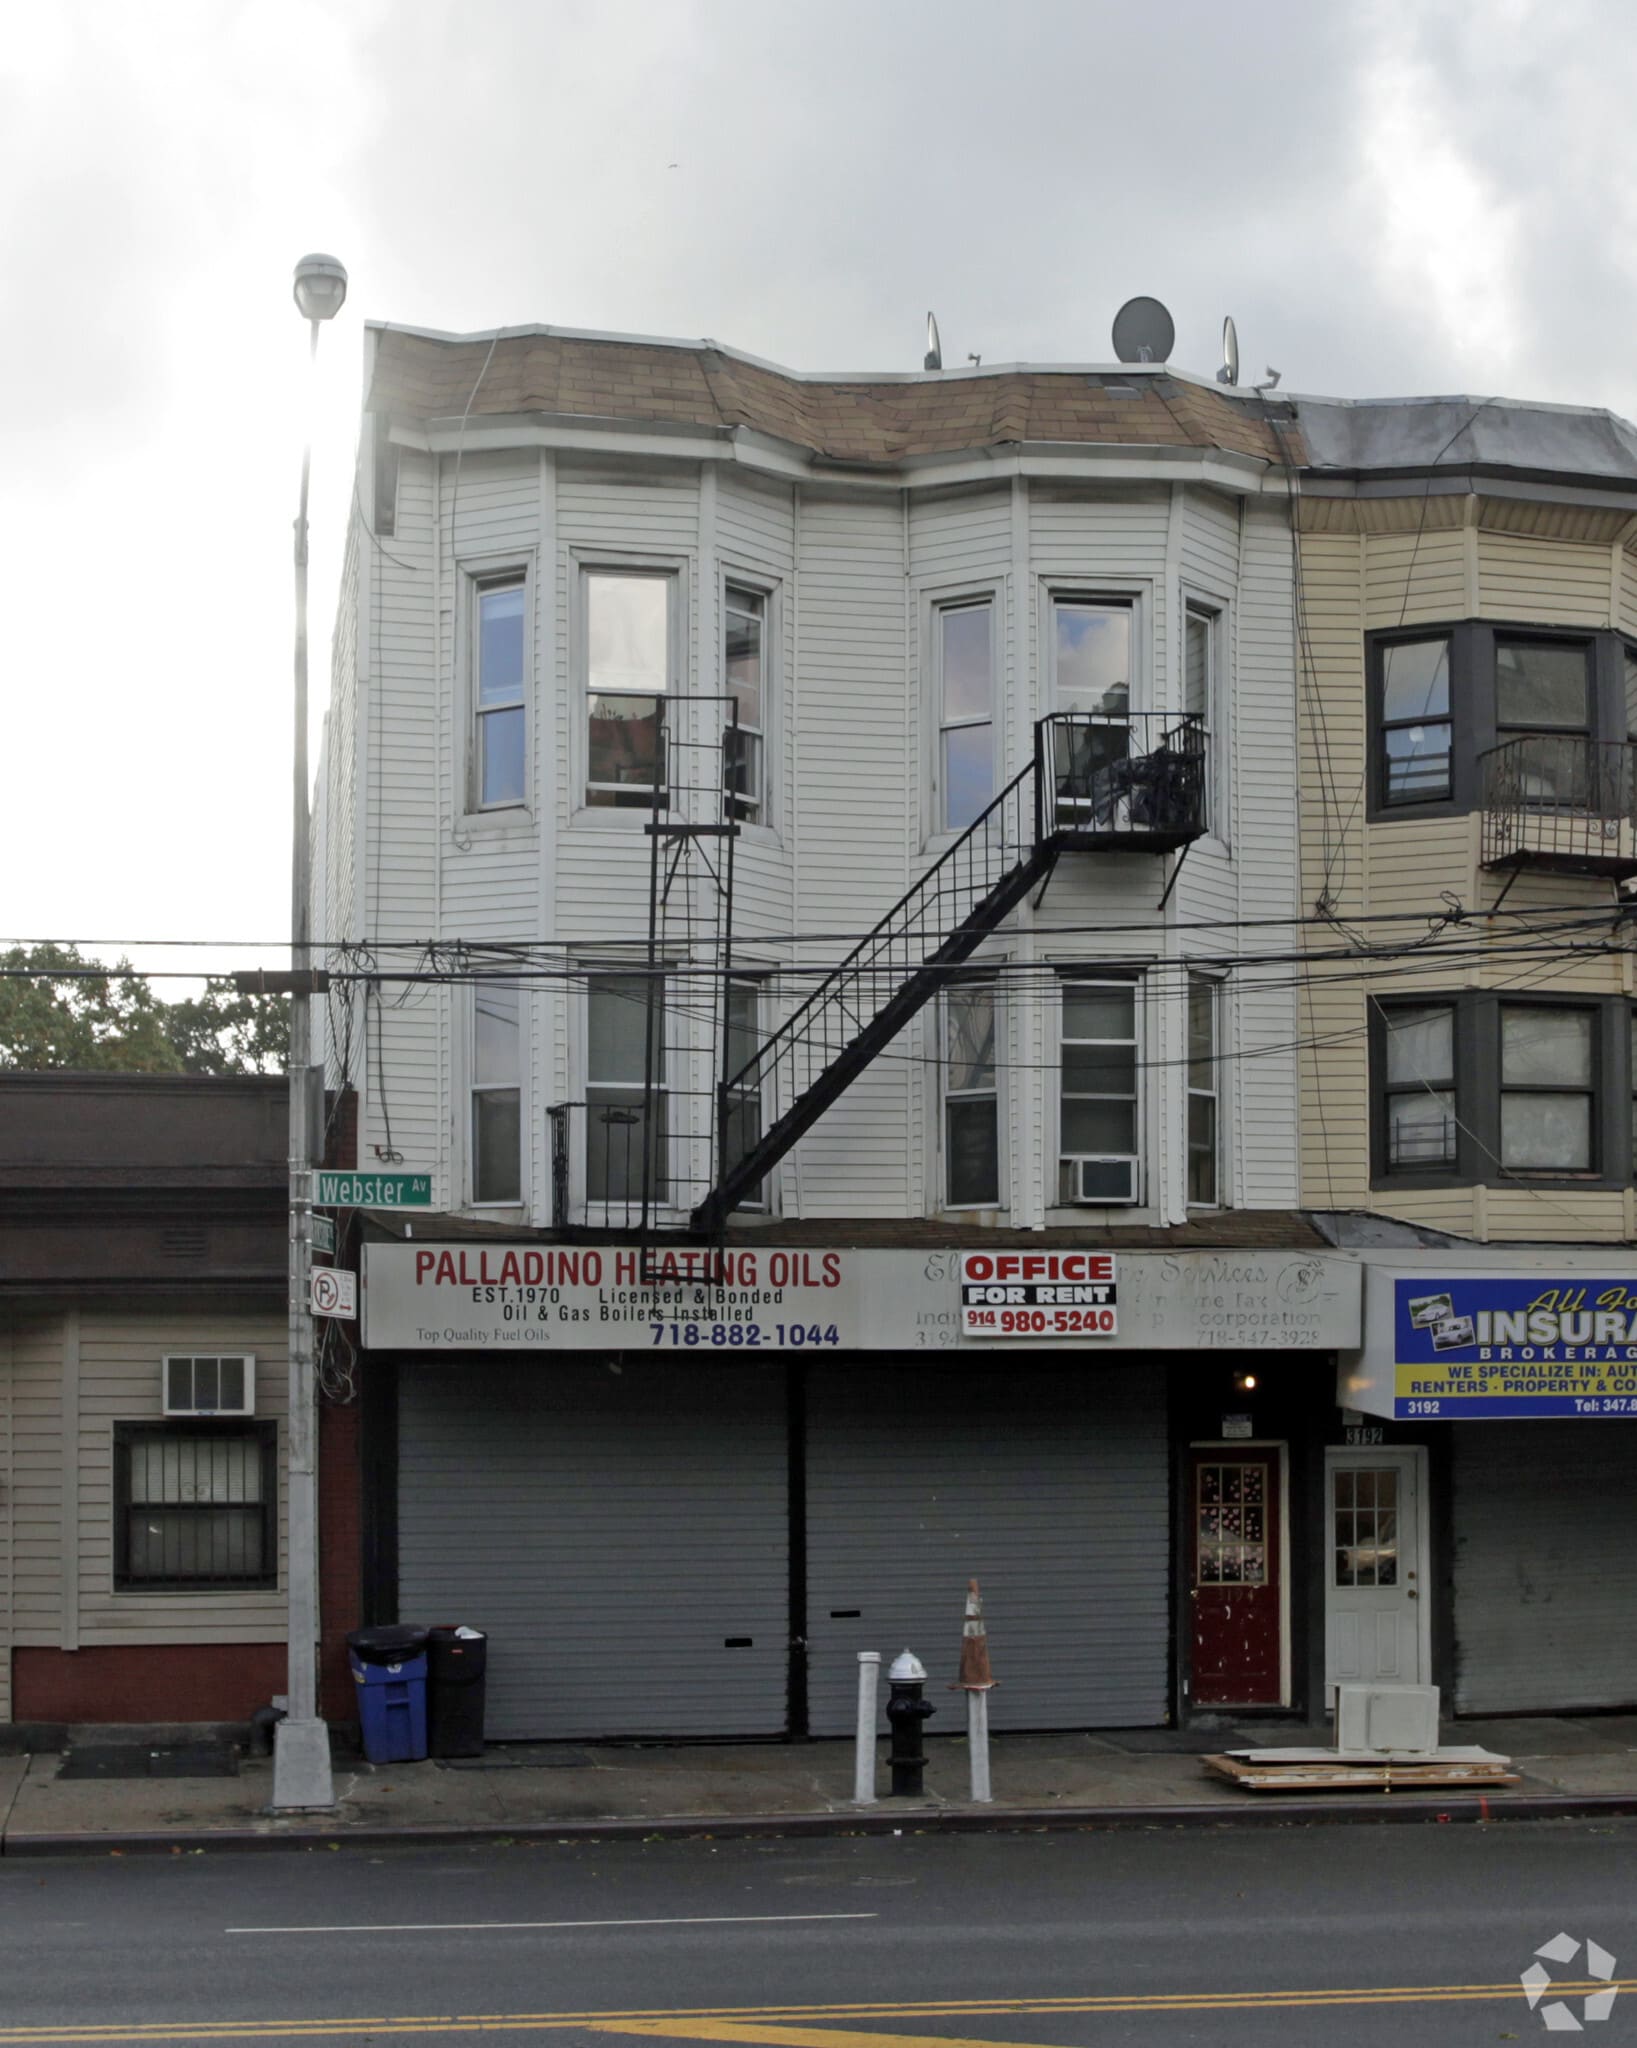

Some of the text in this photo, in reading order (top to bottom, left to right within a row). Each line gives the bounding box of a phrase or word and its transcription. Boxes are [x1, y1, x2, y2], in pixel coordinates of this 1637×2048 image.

[322, 1176, 426, 1203] Webster Av
[415, 1250, 841, 1288] PALLADINO HEATING OILS
[965, 1255, 1113, 1281] OFFICE
[473, 1287, 783, 1304] EST.1970 Licensed & Bonded
[968, 1286, 1110, 1304] FOR RENT
[1527, 1288, 1587, 1313] All
[503, 1304, 753, 1321] Oil & Gas Boilers Installed
[968, 1310, 996, 1327] 914
[1001, 1310, 1114, 1332] 980-5240
[416, 1328, 550, 1344] Top Quality Fuel Oils
[649, 1323, 840, 1346] 718-882-1044
[1448, 1367, 1472, 1379] WE
[1479, 1366, 1573, 1378] SPECIALIZE
[1580, 1366, 1601, 1378] IN:
[1411, 1381, 1488, 1394] RENTERS
[1503, 1380, 1591, 1393] PROPERTY
[1596, 1380, 1607, 1392] &
[1408, 1401, 1440, 1414] 3192
[1575, 1399, 1599, 1412] Tel:
[1346, 1428, 1383, 1445] 3192
